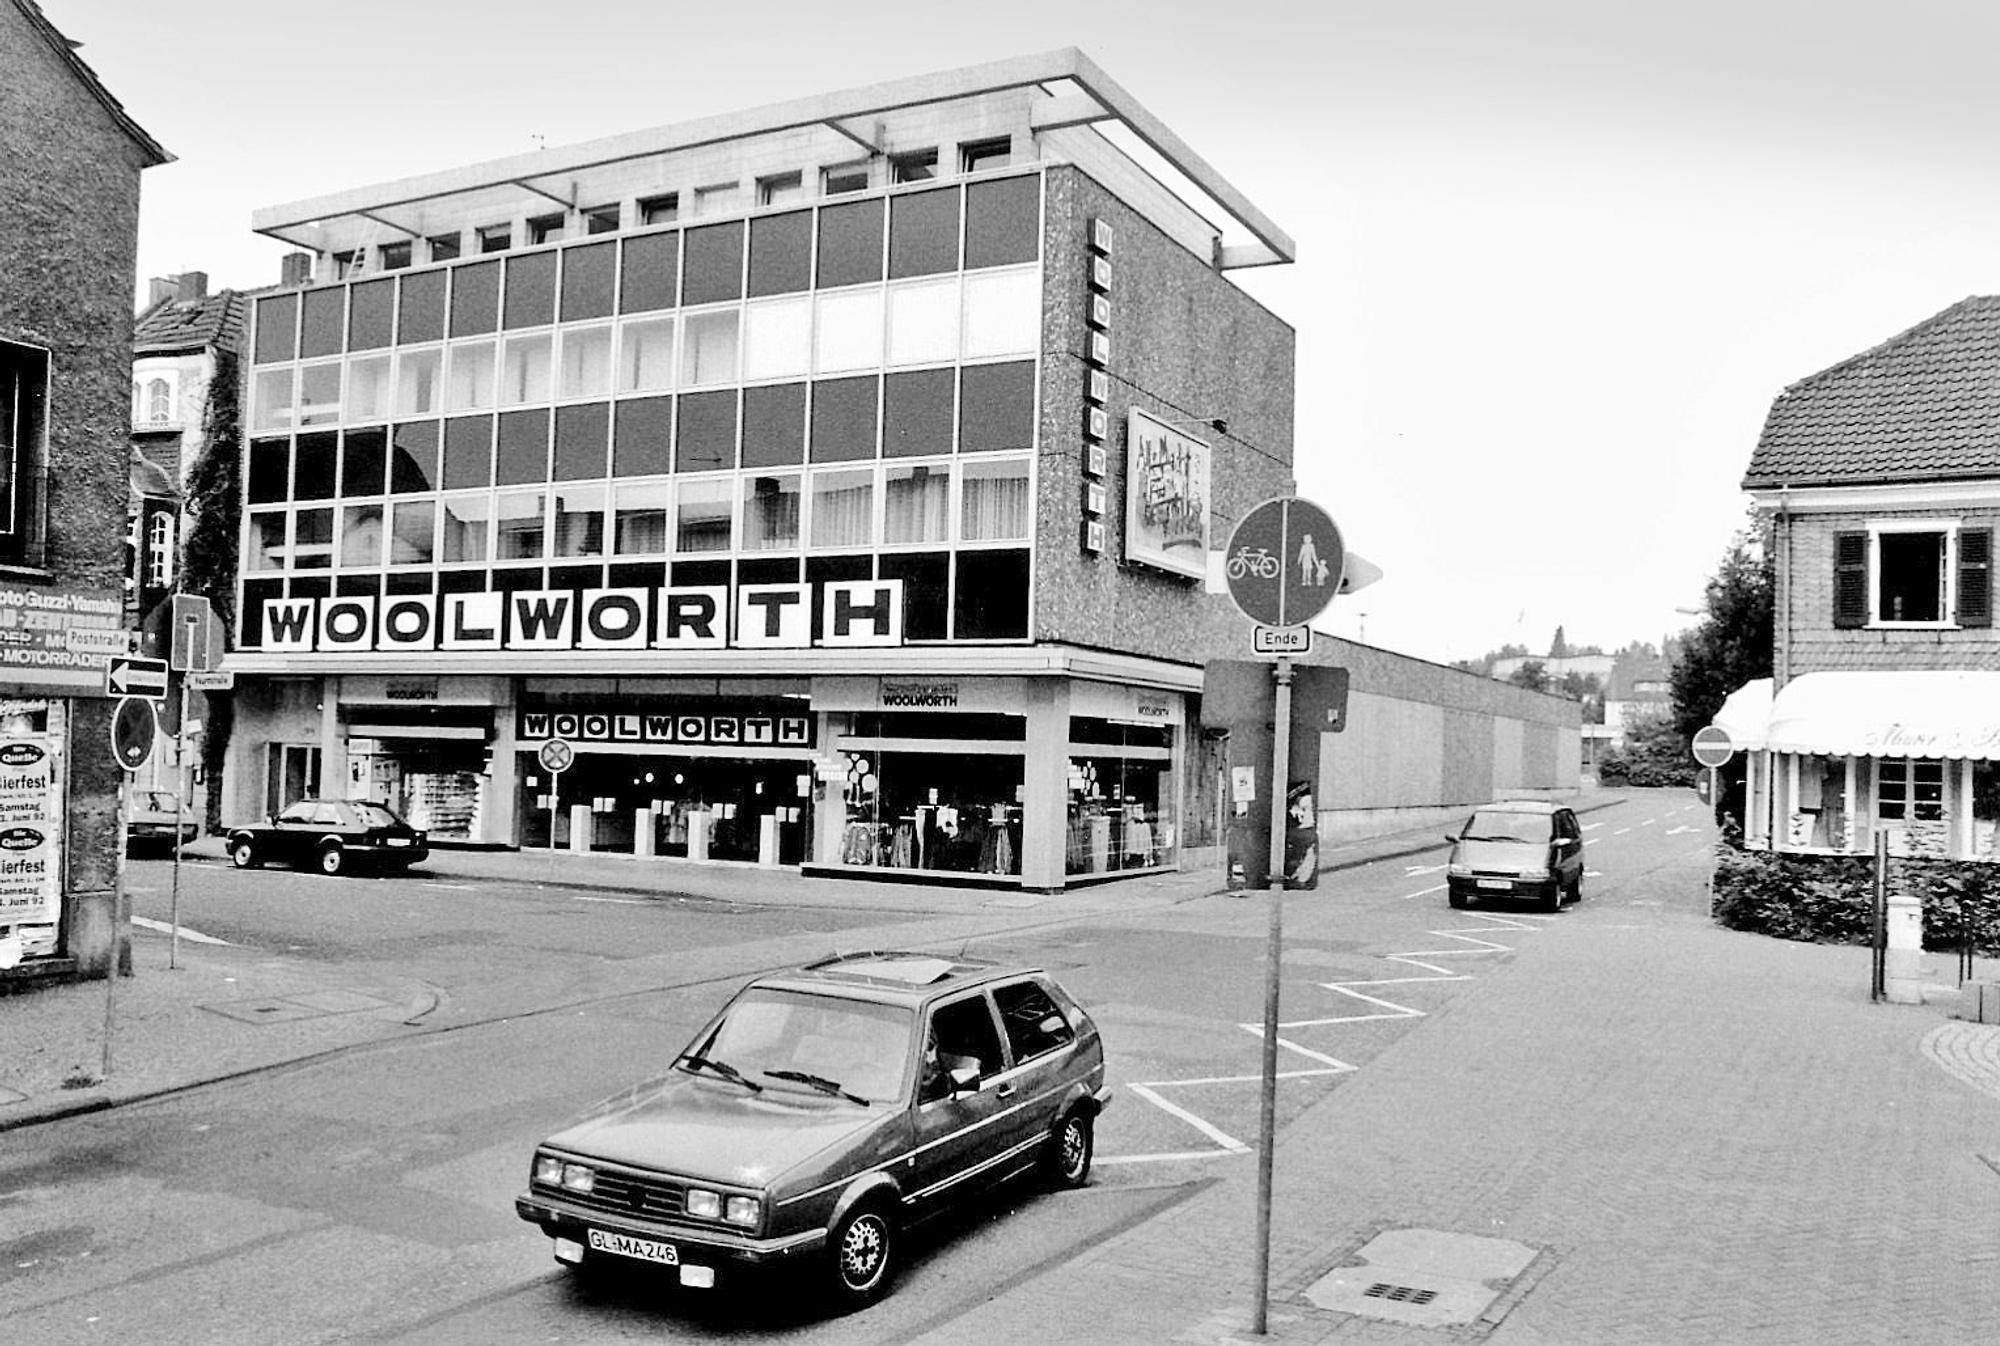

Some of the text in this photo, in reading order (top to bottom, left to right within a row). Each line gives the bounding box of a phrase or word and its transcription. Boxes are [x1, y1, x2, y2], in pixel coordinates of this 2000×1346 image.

[1088, 221, 1112, 551] WOOLWORTH
[266, 586, 893, 644] WOOLWORTH
[1265, 632, 1298, 645] Ende
[883, 695, 957, 706] WOOLWORTH
[525, 714, 808, 741] WOOLWORTH
[0, 775, 45, 789] ierfest
